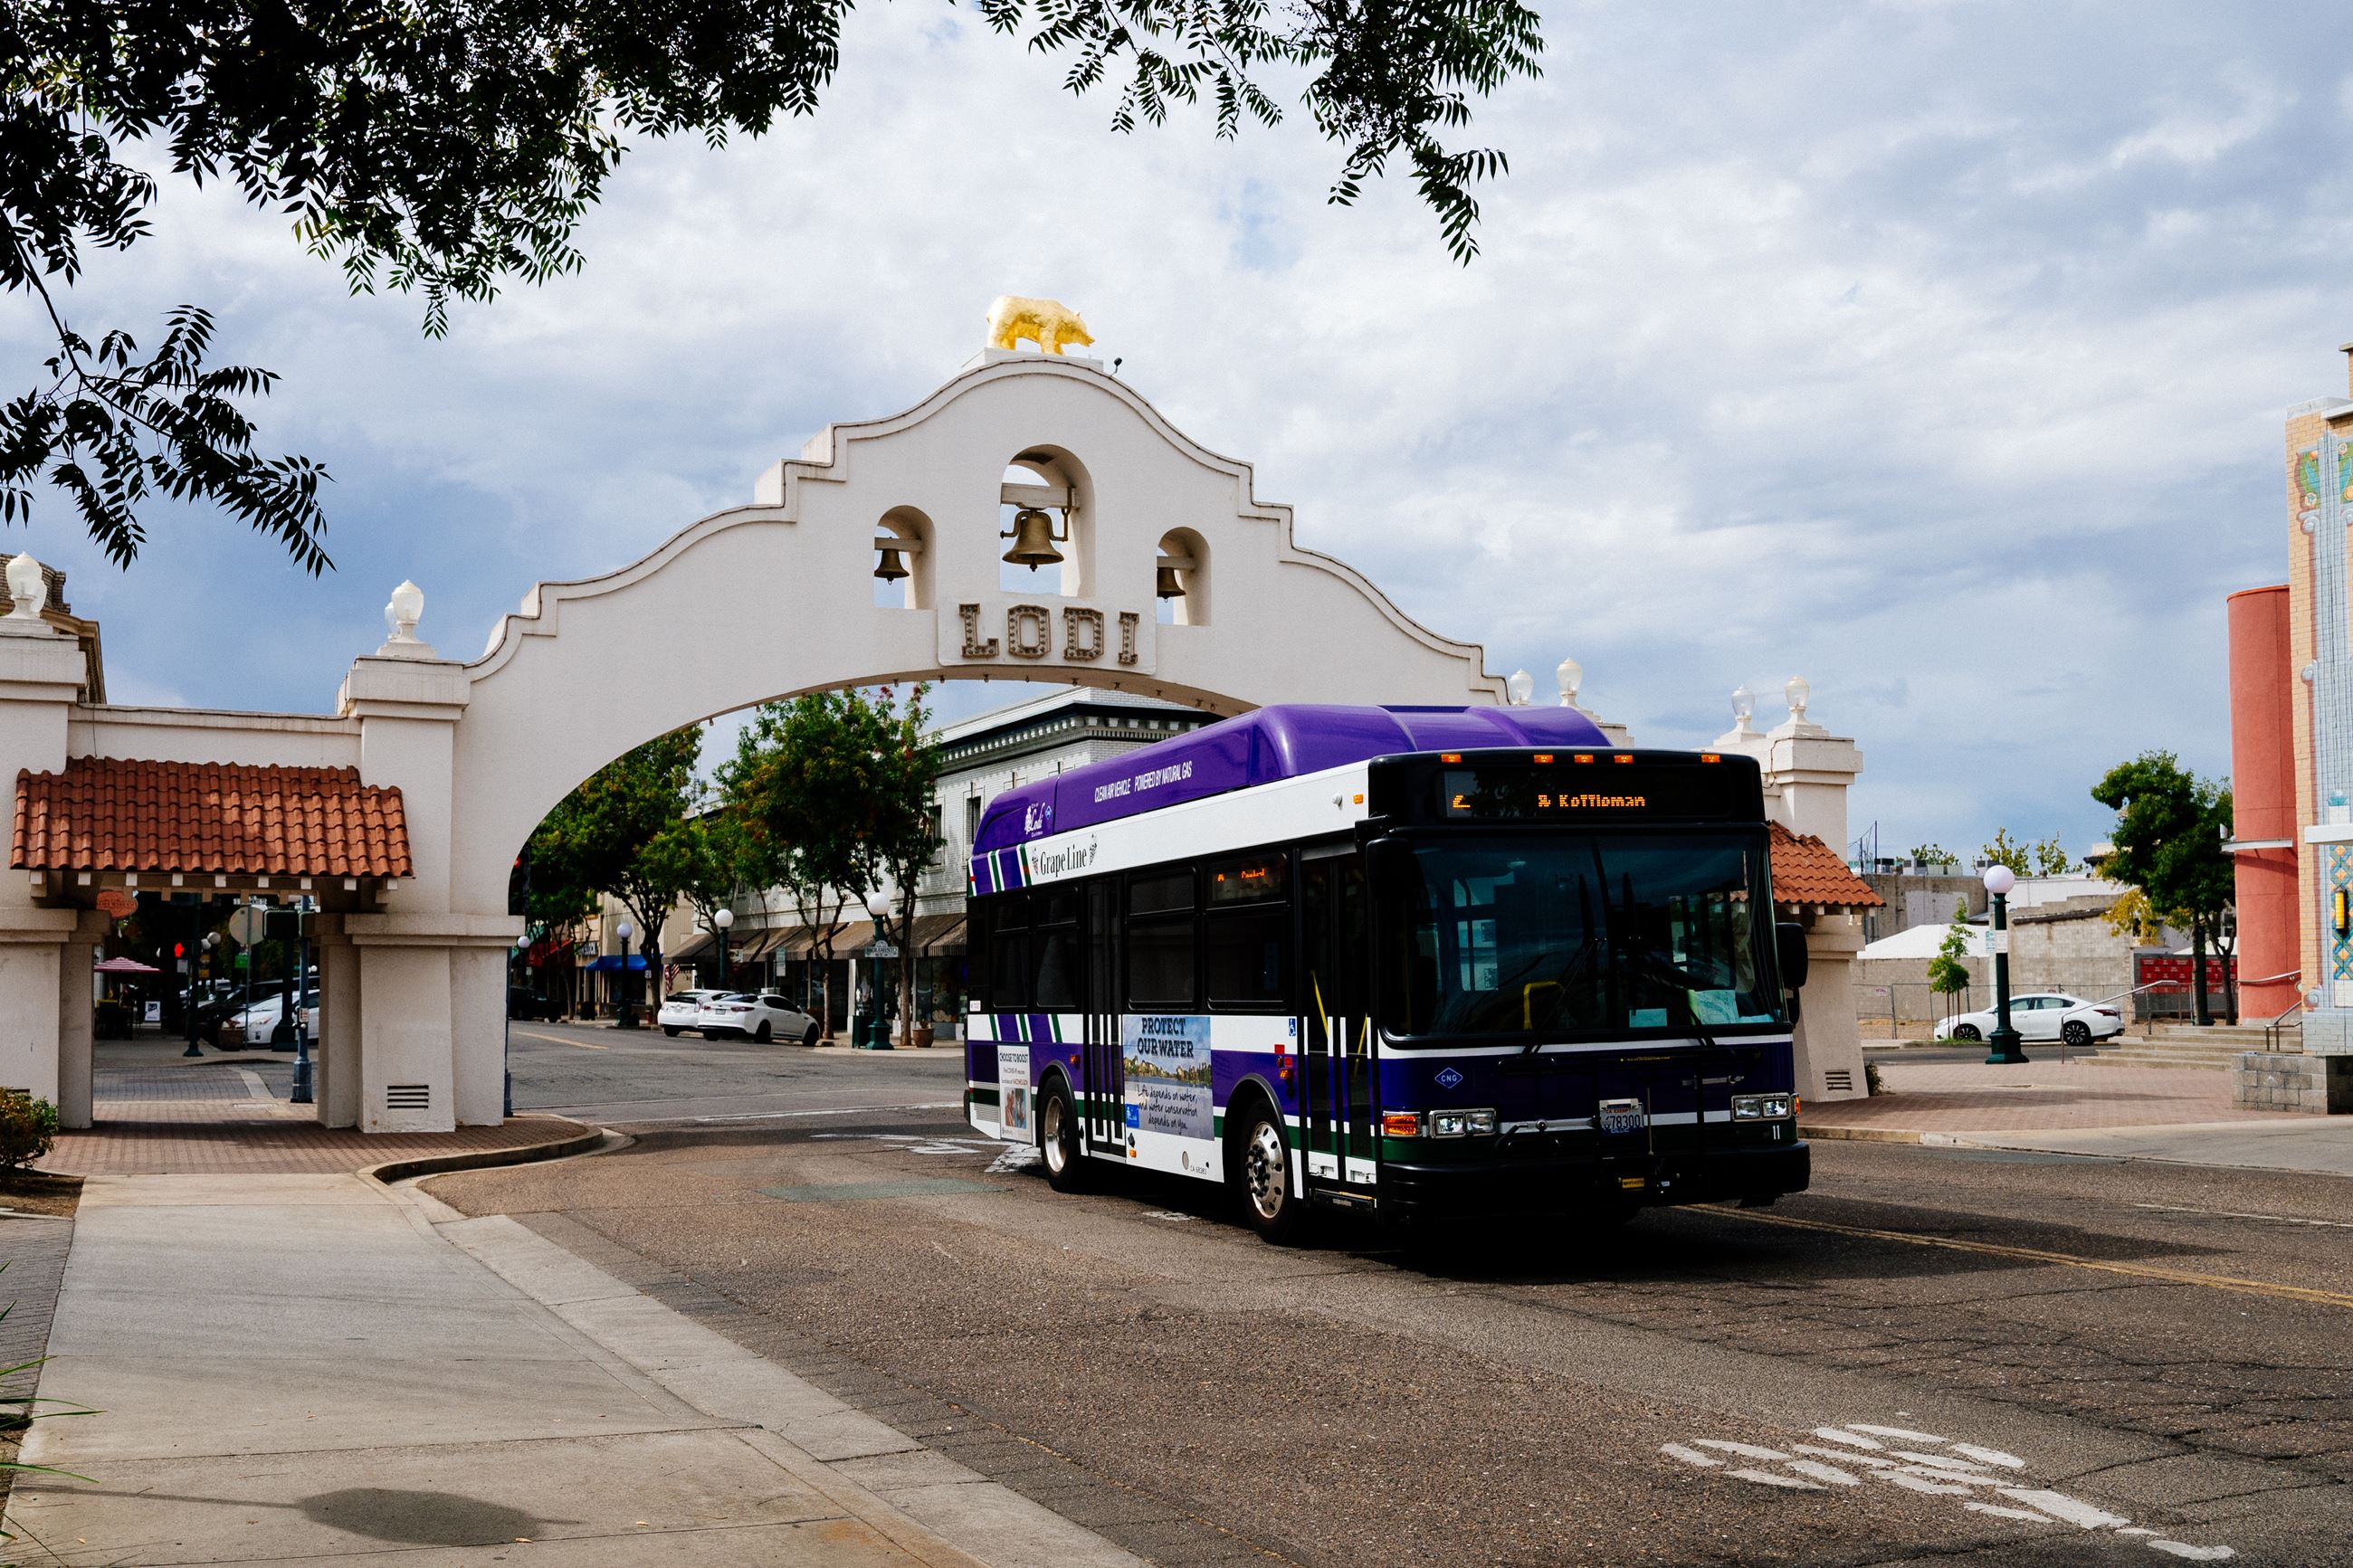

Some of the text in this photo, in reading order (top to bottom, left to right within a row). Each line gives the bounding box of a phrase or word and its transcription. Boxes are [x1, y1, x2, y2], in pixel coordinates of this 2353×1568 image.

[958, 603, 1139, 666] LODI
[1134, 760, 1193, 793] POWERED BY NATURAL GAS
[1094, 785, 1108, 803] CLEAN
[1114, 778, 1131, 798] VEHICLE
[1031, 803, 1045, 831] Lodi
[1040, 844, 1087, 878] Grape Line
[1141, 1017, 1186, 1036] PROTECT
[999, 1052, 1012, 1062] CHOOSE
[1016, 1054, 1028, 1063] BOOST
[1137, 1037, 1195, 1059] OUR WATER
[1441, 1074, 1457, 1082] CNG
[1137, 1084, 1198, 1104] Life depends on water,
[1138, 1099, 1198, 1117] and water conservation
[1148, 1113, 1170, 1129] depends
[1170, 1119, 1176, 1128] on
[1772, 1125, 1780, 1140] 11
